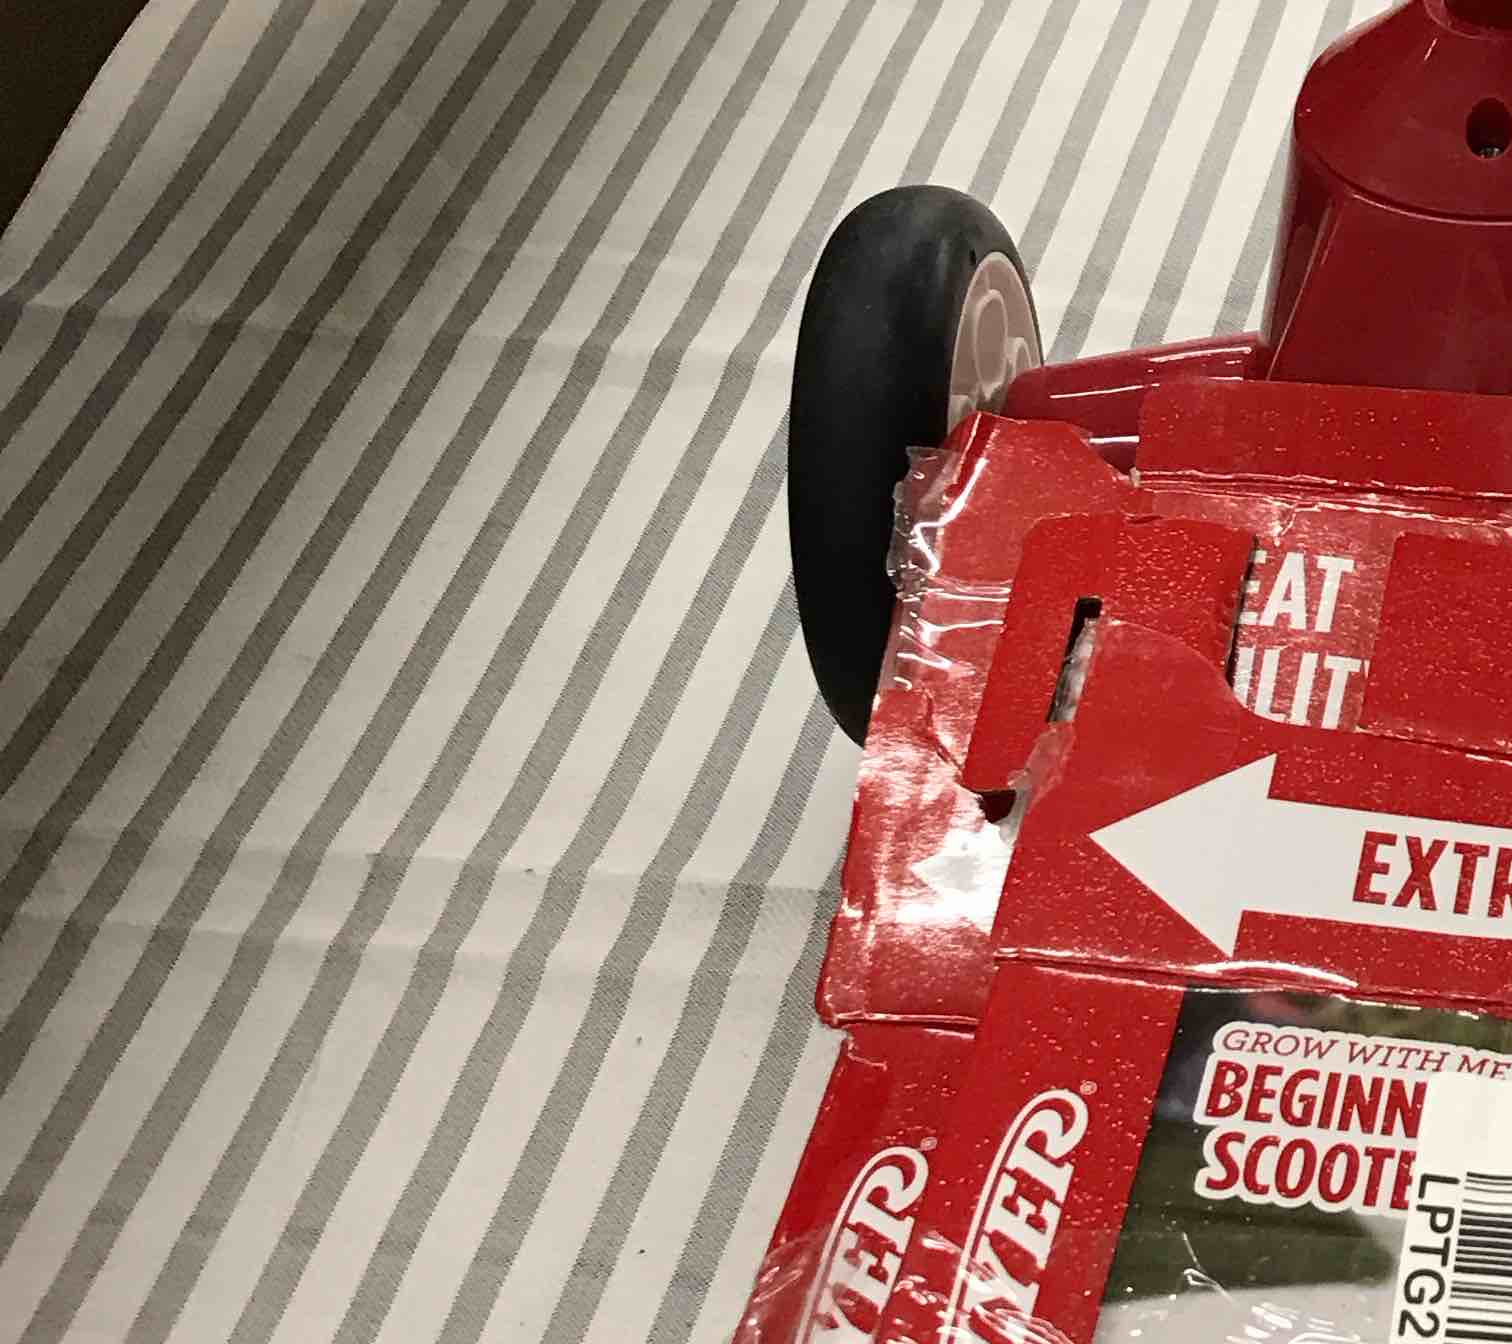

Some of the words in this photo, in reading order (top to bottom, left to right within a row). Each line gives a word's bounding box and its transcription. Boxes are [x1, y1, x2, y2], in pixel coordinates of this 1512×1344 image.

[1222, 1028, 1340, 1059] GROW
[1347, 1041, 1449, 1073] WITH
[1456, 1054, 1512, 1080] ME
[1204, 1059, 1428, 1140] BEGINN
